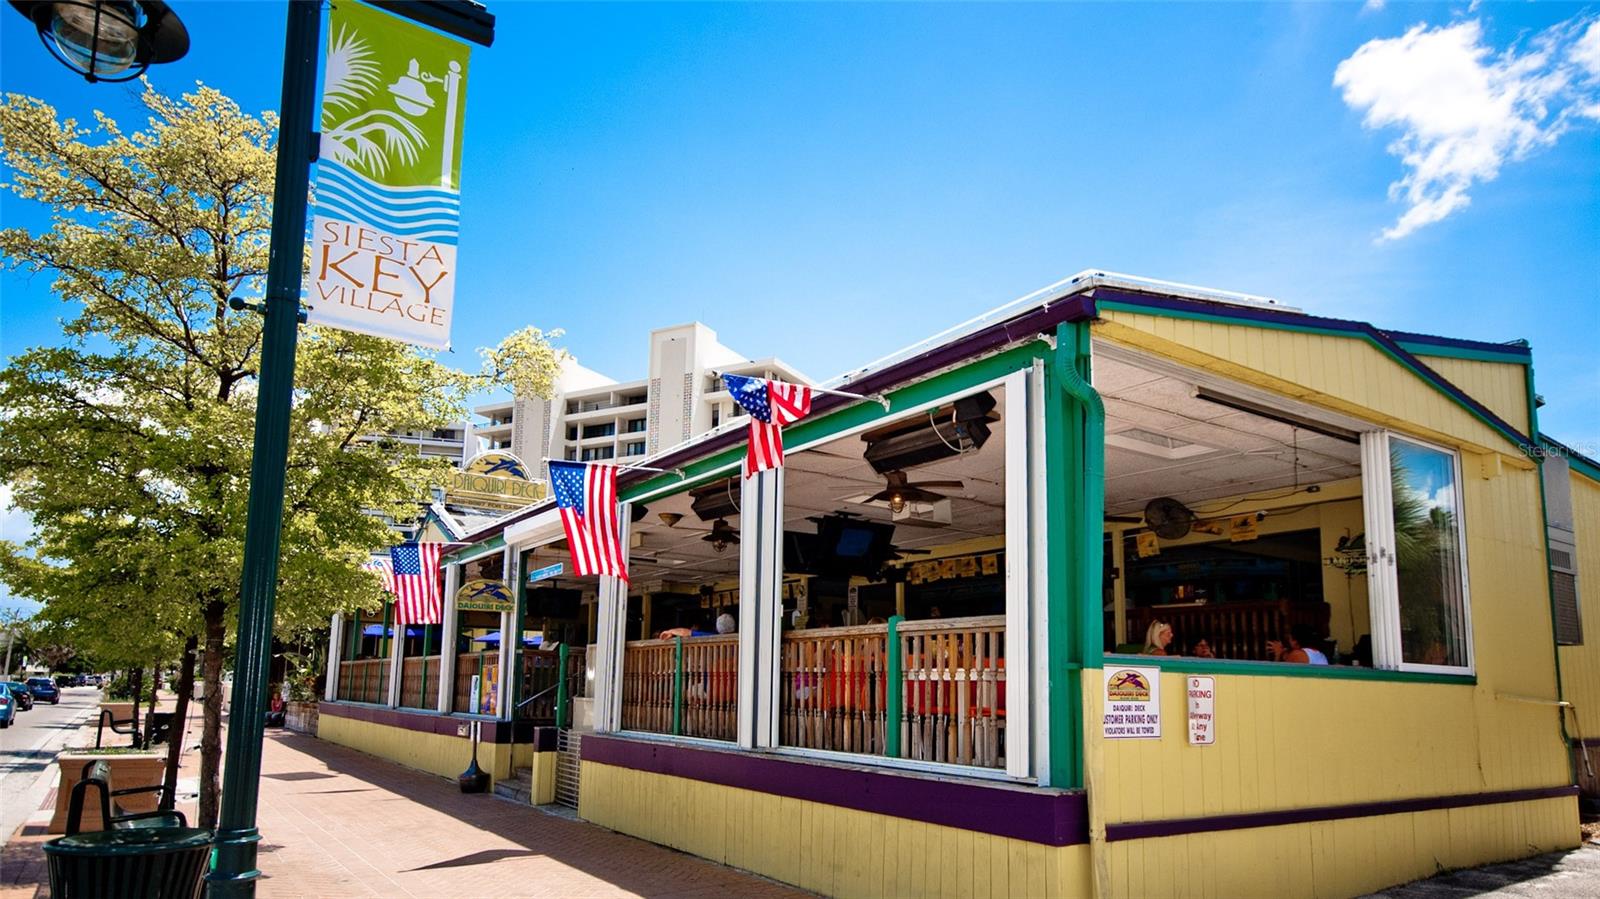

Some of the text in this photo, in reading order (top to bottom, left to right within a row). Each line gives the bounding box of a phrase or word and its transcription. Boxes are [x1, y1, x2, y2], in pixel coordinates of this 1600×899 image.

[322, 221, 443, 265] SIESTA
[319, 244, 448, 303] KEY
[316, 282, 446, 326] VILLAGE
[453, 473, 540, 499] DAIQUIRI DECK
[458, 602, 513, 611] DAIQUIRI DECK
[1103, 714, 1158, 724] USTOMER PARKING ONLY
[1104, 726, 1154, 735] VIOLATORS WILL BE TOWED
